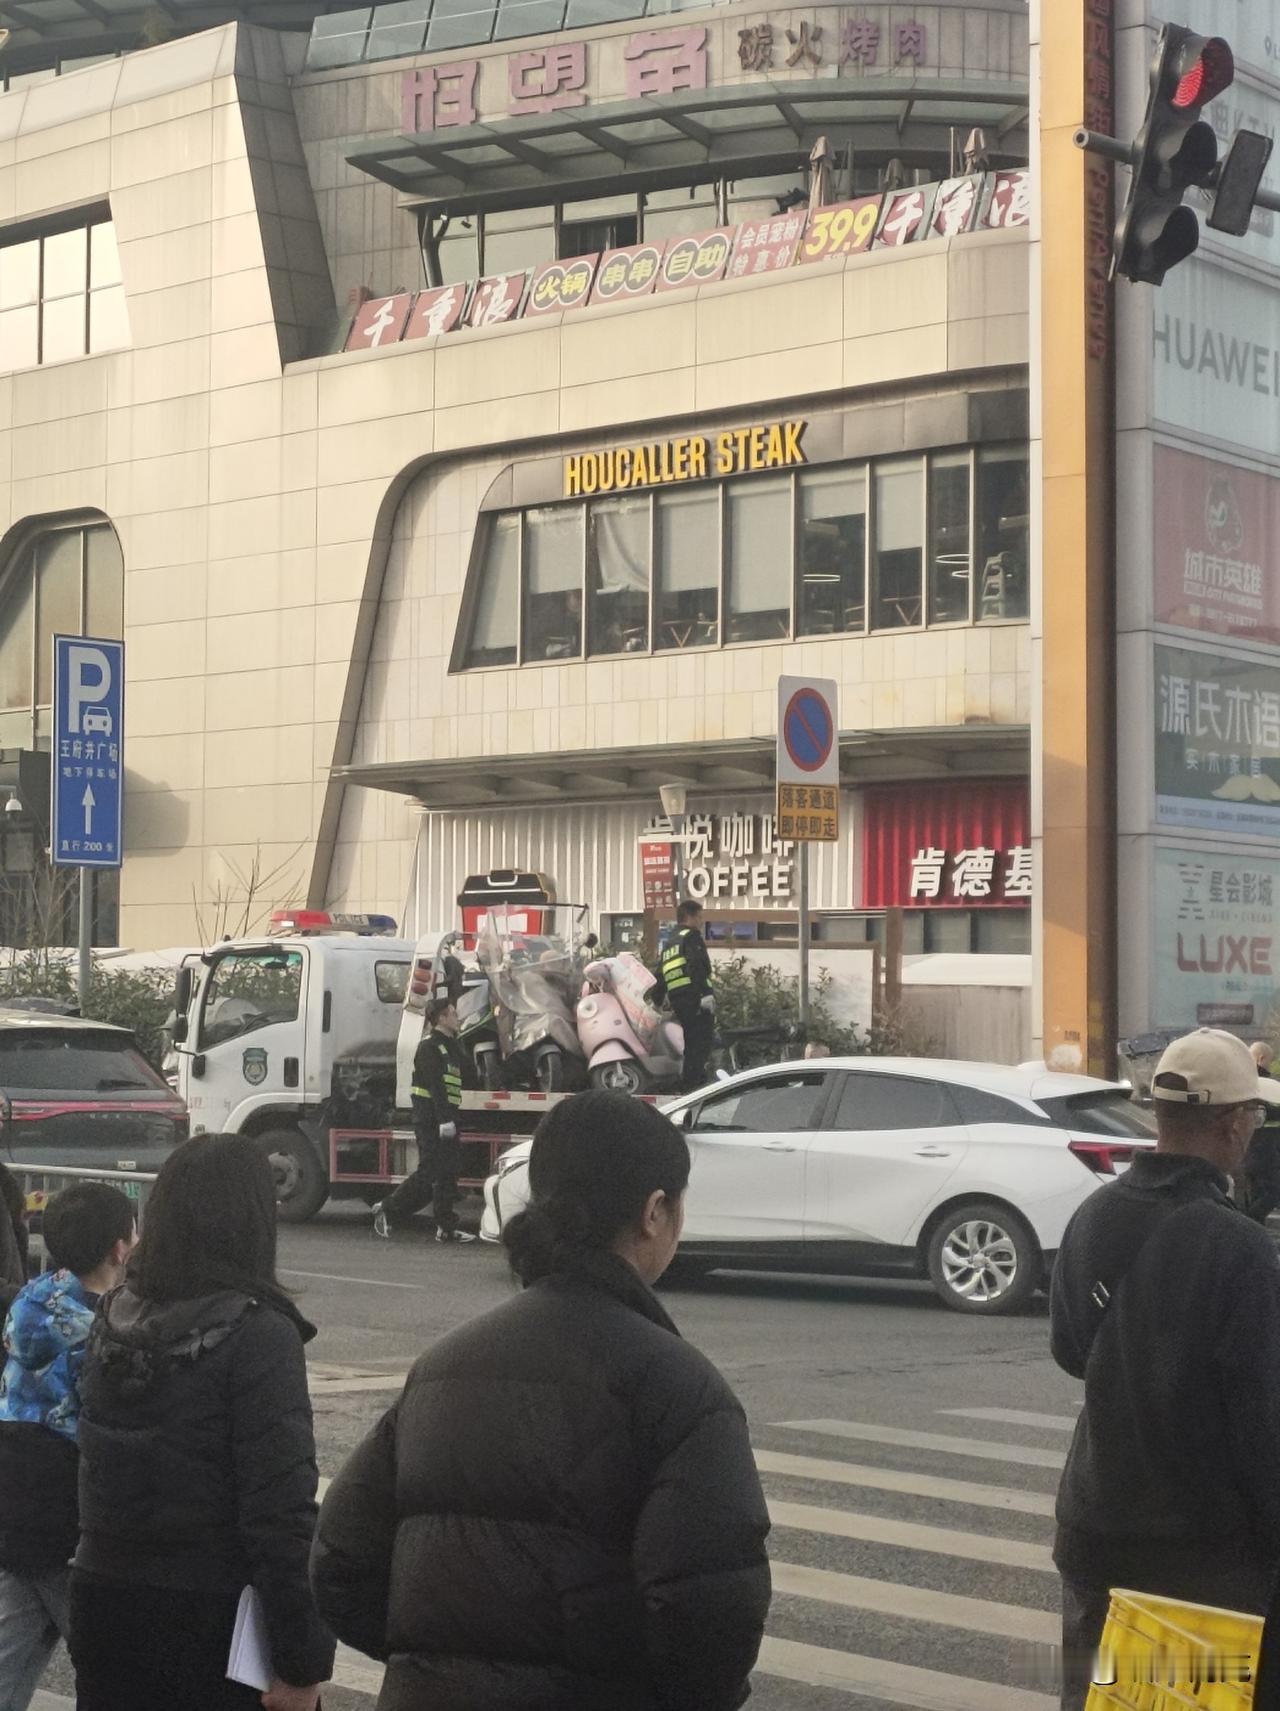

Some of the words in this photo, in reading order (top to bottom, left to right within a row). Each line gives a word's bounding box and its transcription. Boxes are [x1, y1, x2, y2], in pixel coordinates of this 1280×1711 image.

[805, 203, 879, 256] 39.9
[535, 271, 588, 302] 火锅
[601, 257, 654, 288] 串串
[667, 244, 726, 276] 自助
[1152, 309, 1280, 398] HUAWEI
[565, 436, 707, 496] HOUCALLER
[716, 420, 804, 474] STEAK
[1183, 547, 1263, 595] 城市英雄
[68, 645, 112, 733] P
[60, 739, 118, 762] 王府井广场
[84, 841, 102, 852] 200
[781, 815, 835, 837] 即停即走
[910, 845, 1032, 898] 肯德基
[1176, 931, 1273, 976] LUXE
